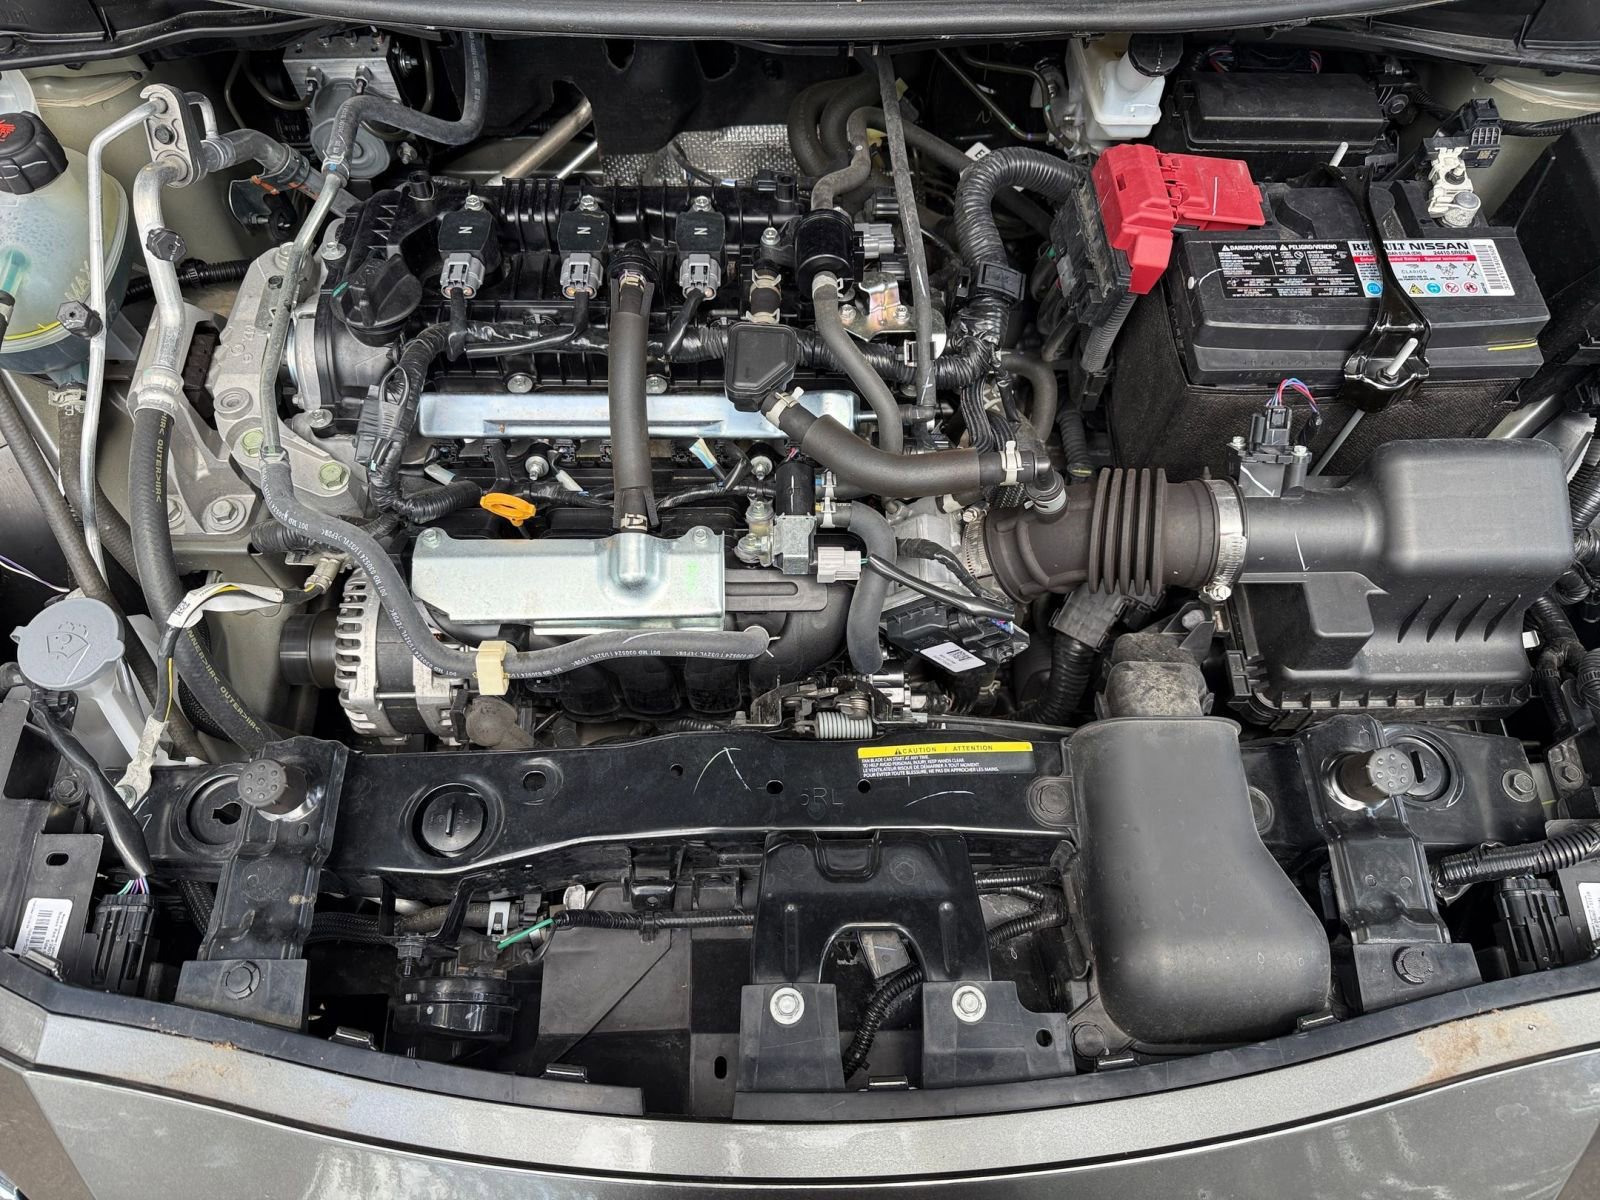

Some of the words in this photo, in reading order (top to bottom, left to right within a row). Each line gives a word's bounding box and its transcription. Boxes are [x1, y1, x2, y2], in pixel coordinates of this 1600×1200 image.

[1352, 242, 1406, 251] REULT
[1409, 242, 1469, 250] NISSAN
[902, 746, 937, 754] CAUTION
[953, 744, 993, 752] ATTENTION
